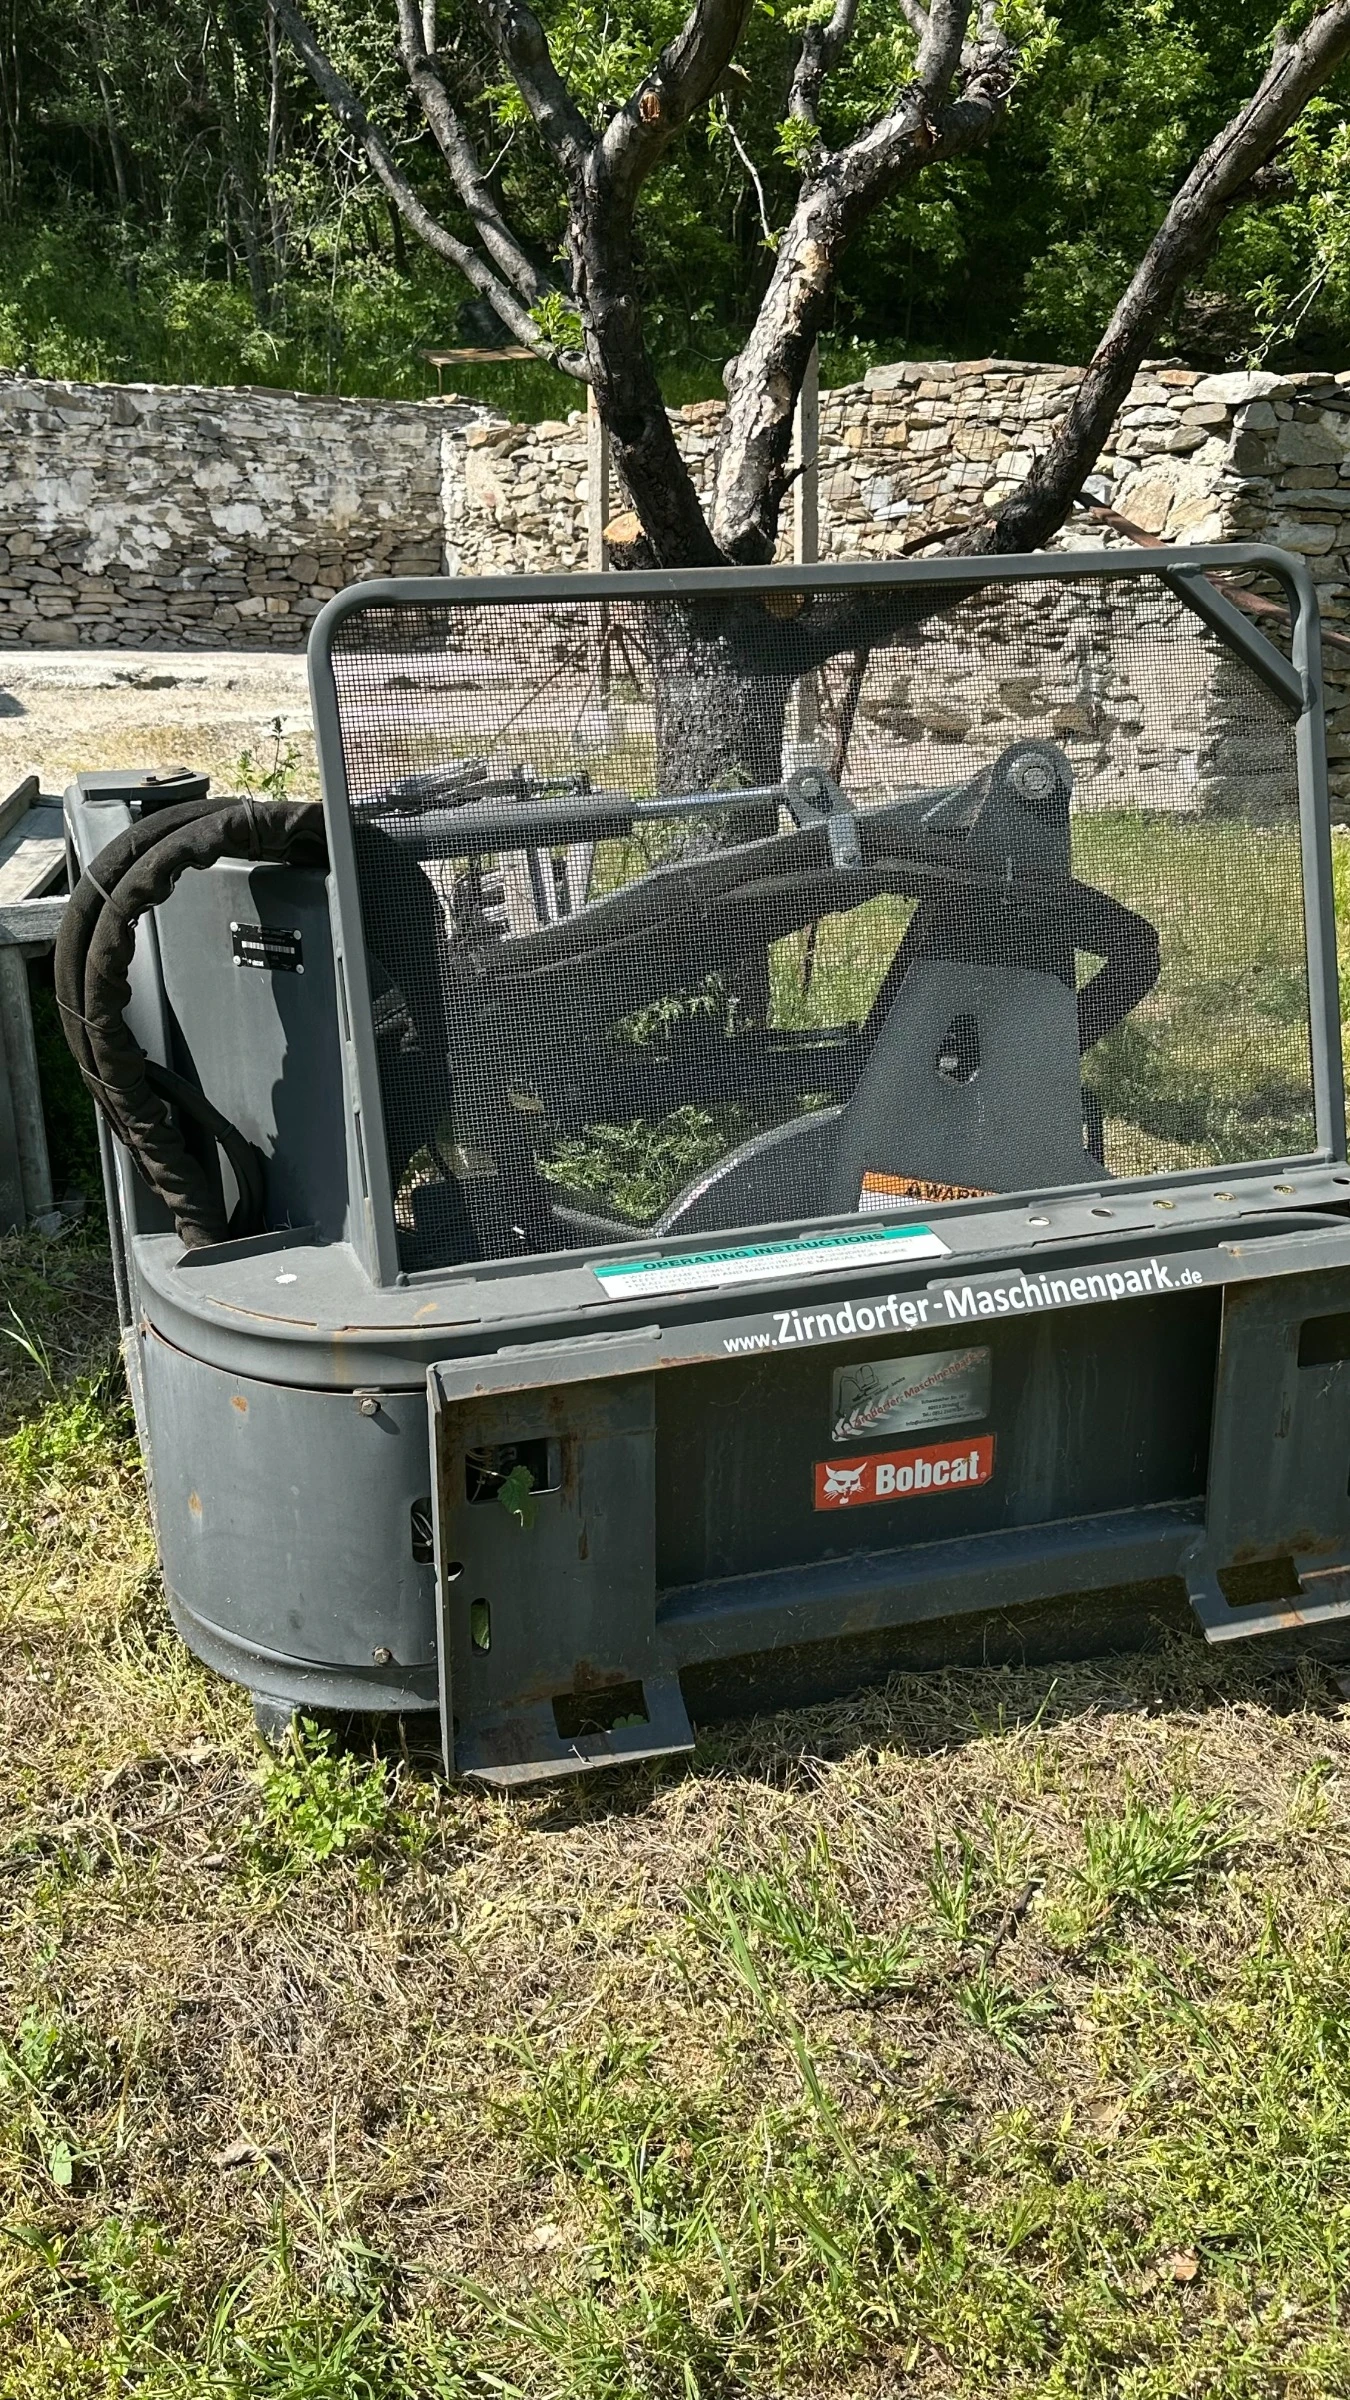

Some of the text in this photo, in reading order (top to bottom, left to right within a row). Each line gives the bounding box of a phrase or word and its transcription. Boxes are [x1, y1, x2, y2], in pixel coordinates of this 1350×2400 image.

[643, 1233, 885, 1270] OPERATING INSTRUCTIONS
[722, 1258, 1203, 1353] www.Zirndorfer-Maschinenpark.de
[875, 1450, 980, 1496] Bobcat
